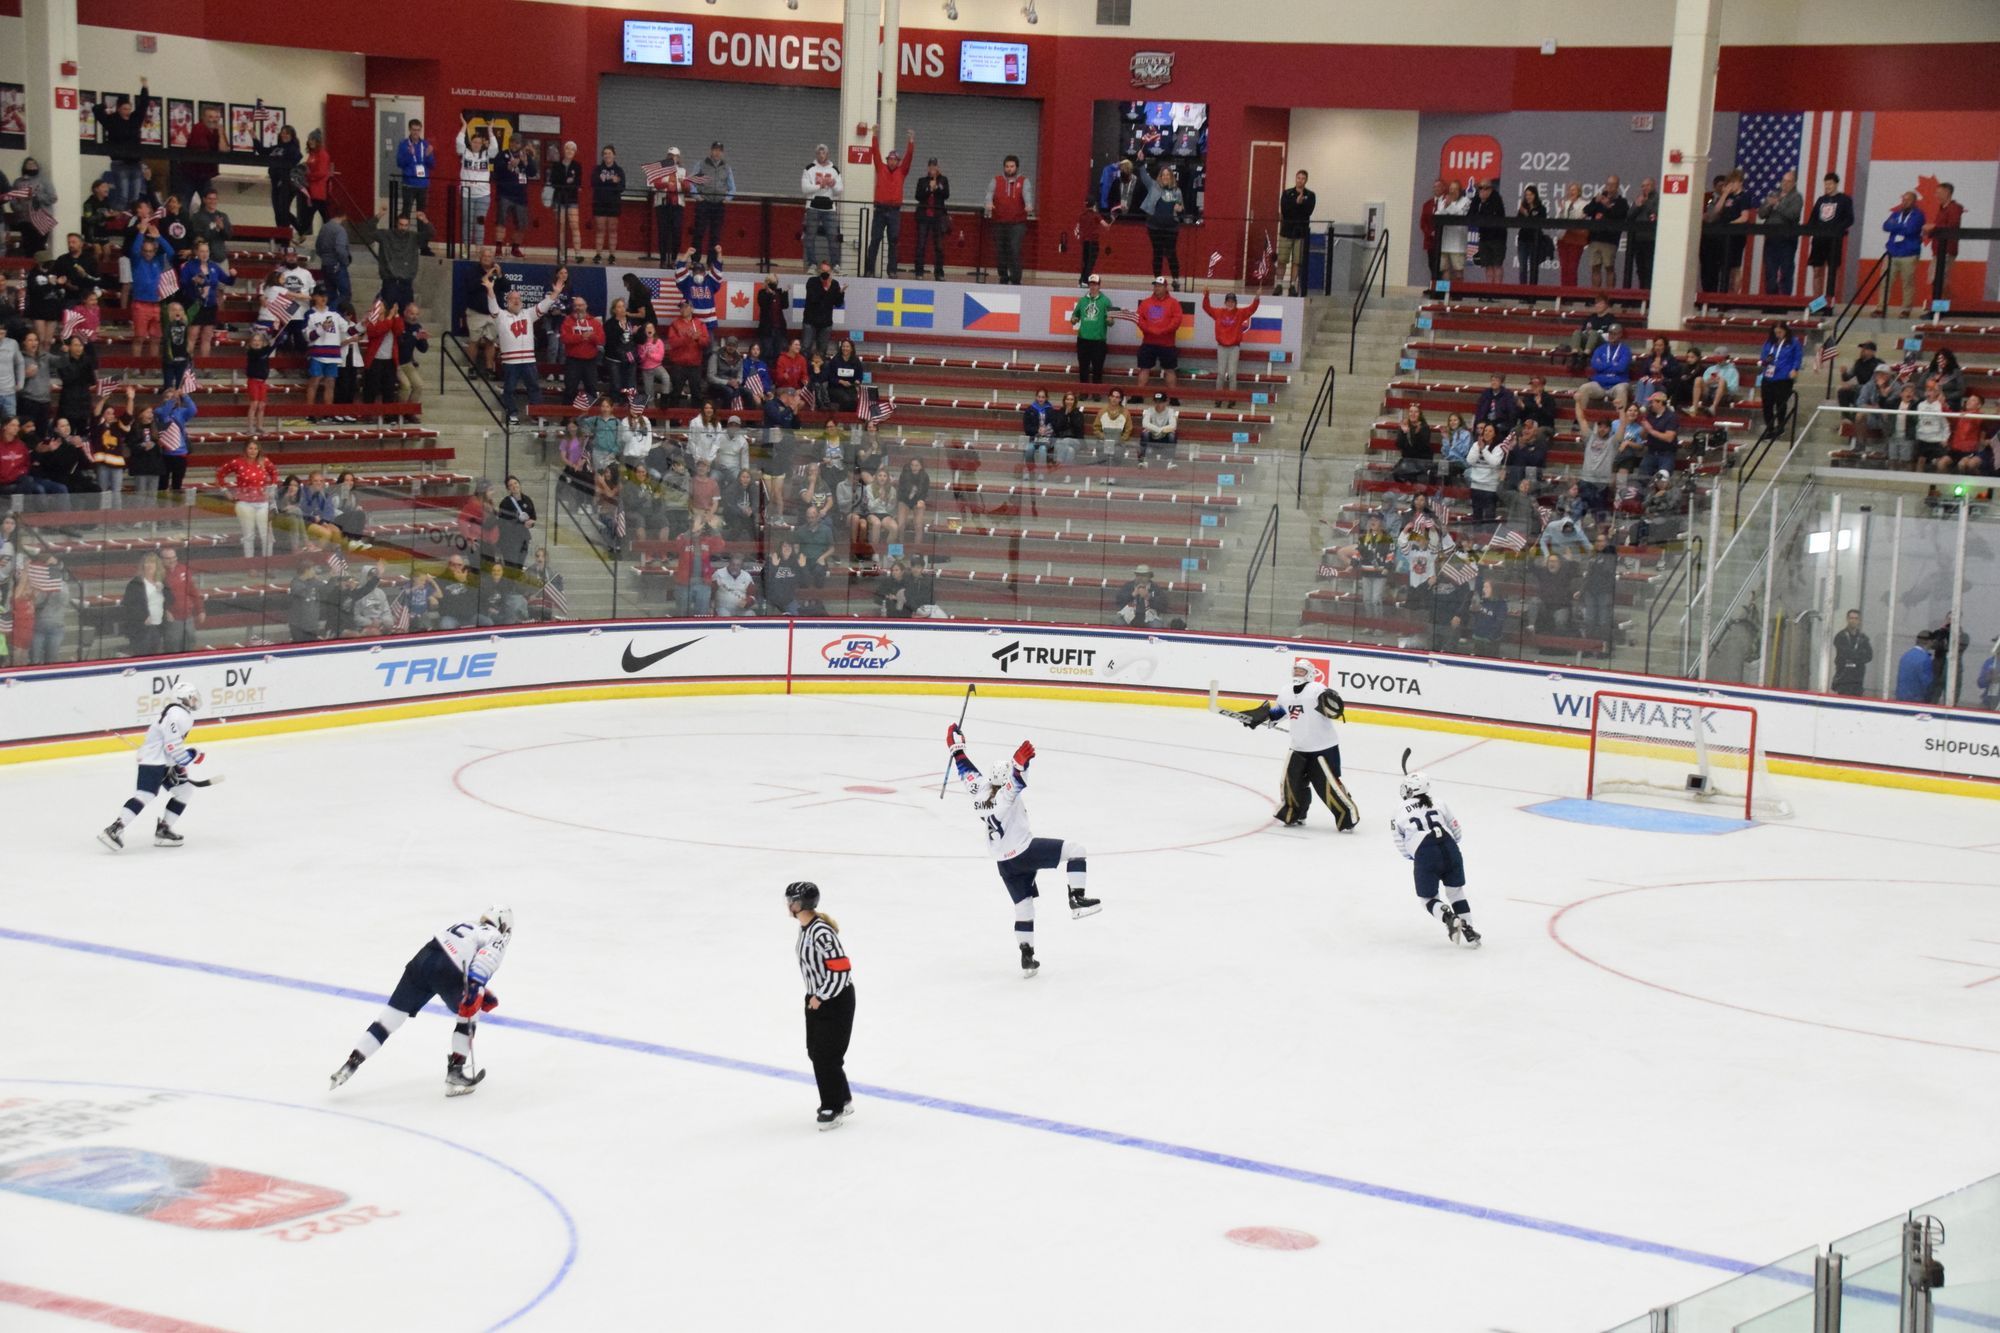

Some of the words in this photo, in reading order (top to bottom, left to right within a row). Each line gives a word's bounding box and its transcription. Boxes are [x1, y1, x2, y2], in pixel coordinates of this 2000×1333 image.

[63, 96, 70, 108] 6
[451, 87, 477, 96] LANCE
[478, 89, 514, 99] JOHNSON
[515, 92, 555, 102] MEMORIAL
[557, 95, 576, 103] RINK
[857, 152, 864, 163] 7
[1449, 151, 1494, 170] IIHF
[1519, 151, 1571, 171] 2022
[1671, 181, 1680, 193] 8
[691, 286, 712, 299] USA
[510, 319, 528, 338] W
[844, 641, 873, 658] USA
[1023, 646, 1096, 667] TRUFIT
[375, 652, 498, 687] TRUE
[828, 657, 889, 669] HOCKEY
[1049, 665, 1094, 677] CUSTOMS
[152, 674, 180, 694] DV
[226, 667, 252, 687] DV
[1337, 671, 1422, 696] TOYOTA
[1552, 692, 1717, 734] WINMARK
[1924, 738, 2000, 758] SHOPUSA
[260, 1204, 402, 1243] 2022
